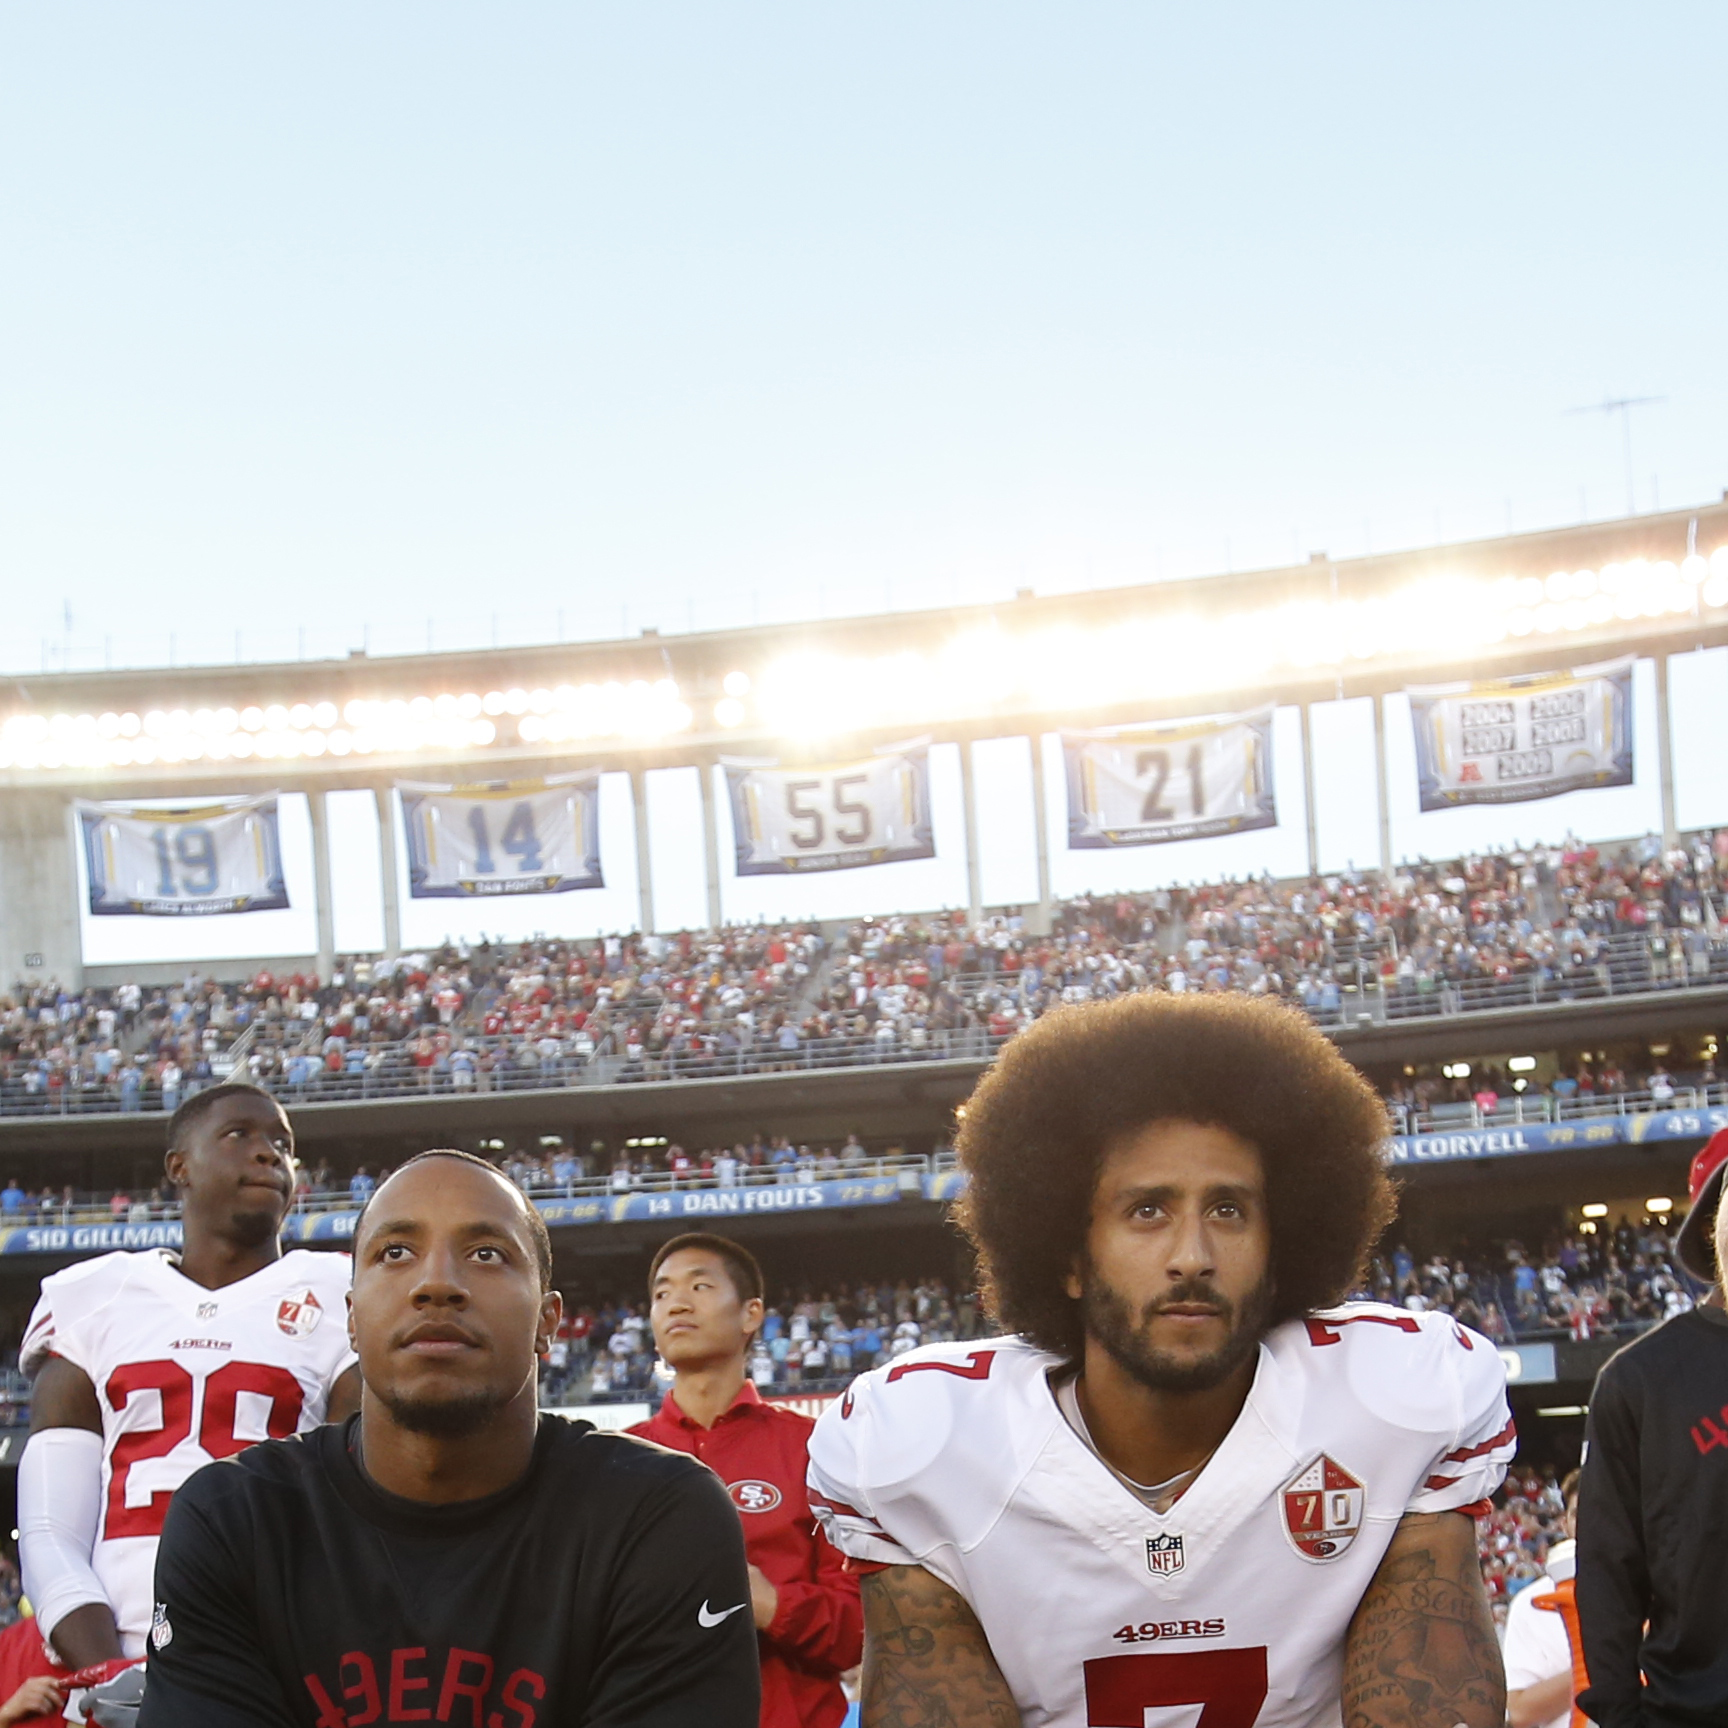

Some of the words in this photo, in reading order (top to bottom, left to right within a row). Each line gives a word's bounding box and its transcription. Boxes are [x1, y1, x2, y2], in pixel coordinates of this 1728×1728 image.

[1135, 743, 1205, 821] 21
[786, 775, 870, 848] 55
[468, 800, 543, 873] 14
[151, 826, 219, 896] 19
[1412, 1131, 1529, 1158] CORYELL
[648, 1198, 671, 1215] 14
[683, 1191, 738, 1212] DAN
[744, 1186, 824, 1209] FOUTS
[27, 1230, 65, 1249] SID
[72, 1227, 183, 1249] GILLMAN
[1305, 1315, 1422, 1346] 7
[739, 1485, 771, 1508] SF
[1297, 1494, 1351, 1528] 70
[1151, 1551, 1181, 1571] NFL
[1113, 1618, 1226, 1643] 49ERS
